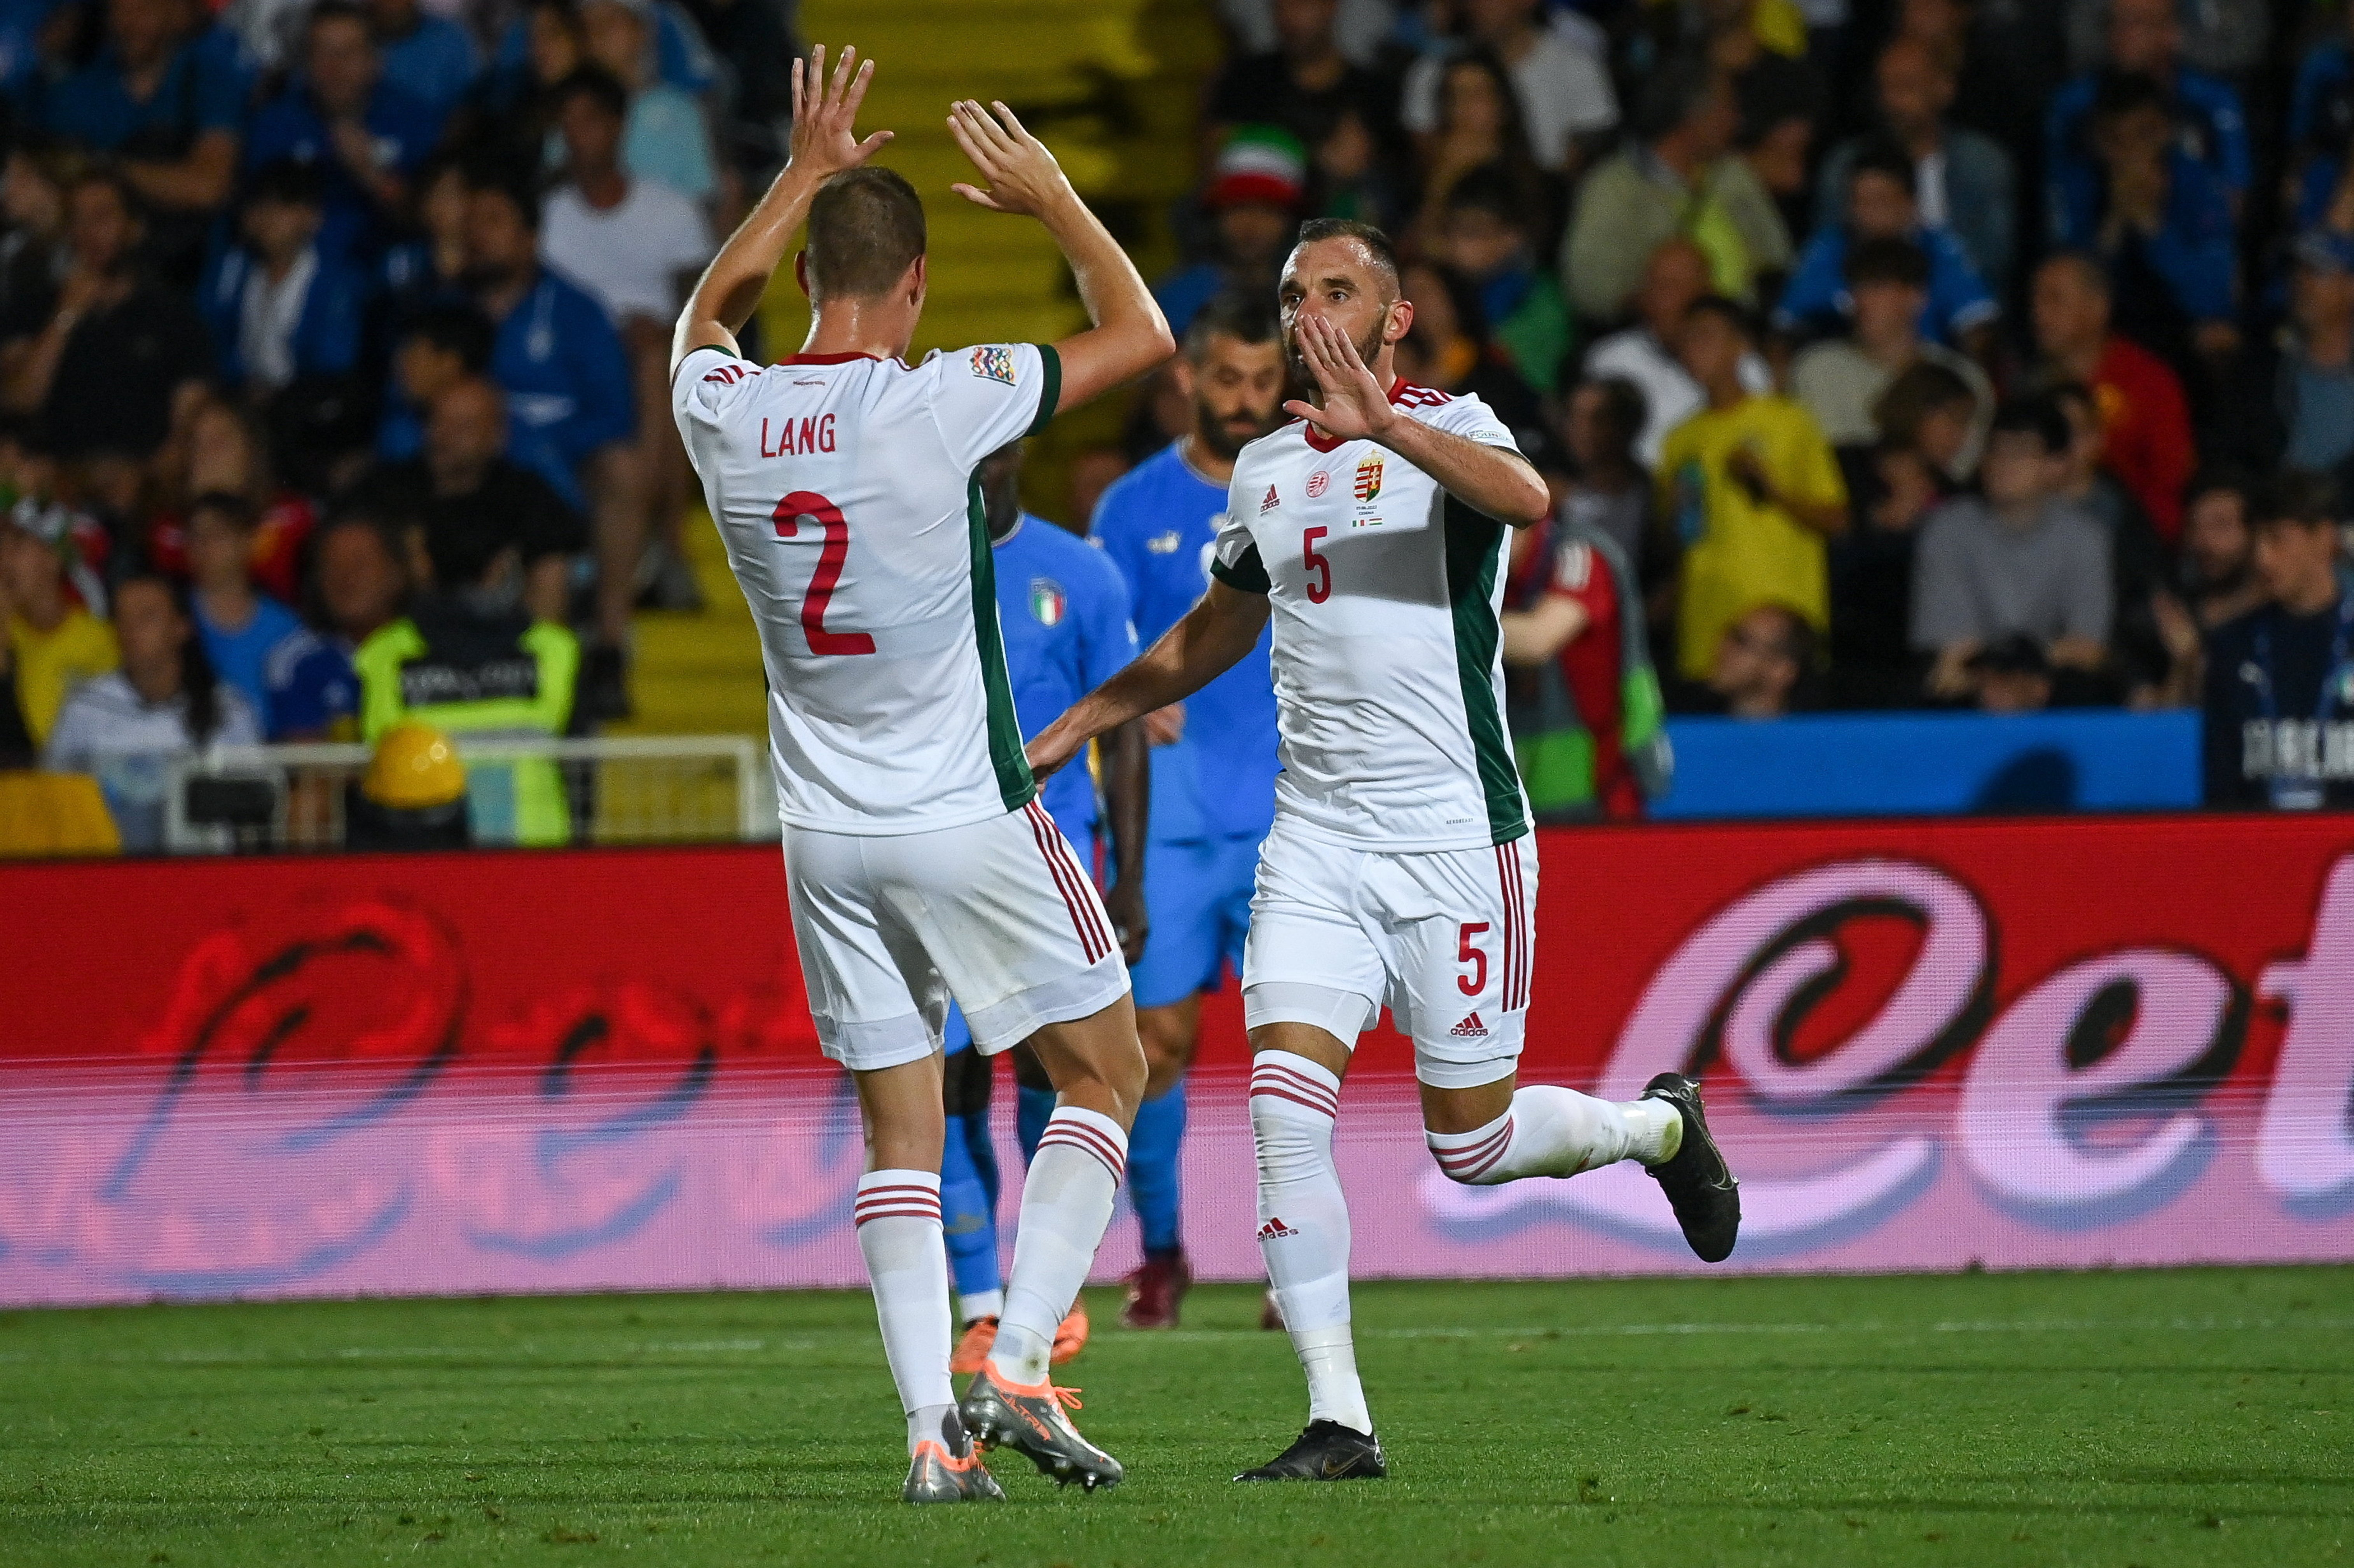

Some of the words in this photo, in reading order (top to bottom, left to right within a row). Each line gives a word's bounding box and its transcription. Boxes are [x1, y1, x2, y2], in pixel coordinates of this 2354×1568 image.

[761, 413, 836, 458] LANG
[772, 491, 876, 655] 2
[1304, 526, 1331, 604] 5
[1458, 922, 1490, 996] 5
[1450, 1027, 1488, 1037] adidas
